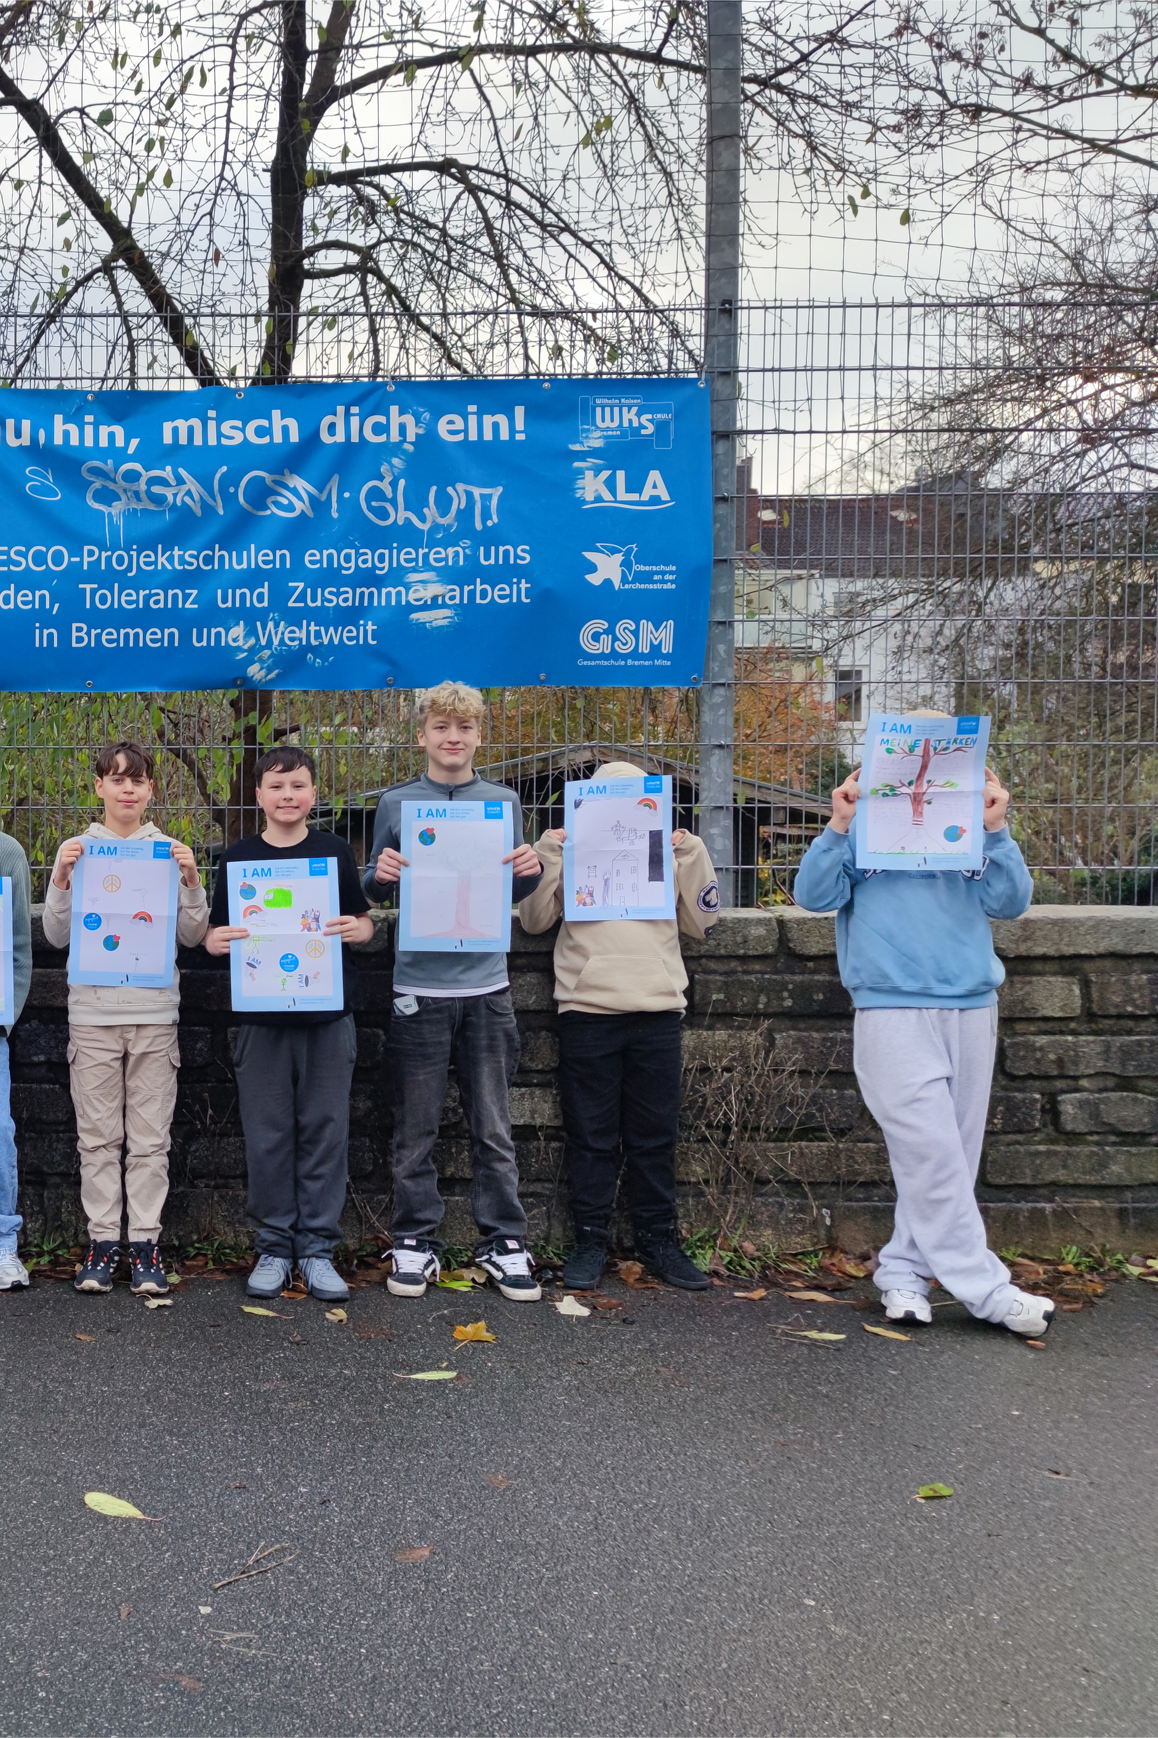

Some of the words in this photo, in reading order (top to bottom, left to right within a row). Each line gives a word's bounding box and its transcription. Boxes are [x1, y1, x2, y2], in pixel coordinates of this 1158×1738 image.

[53, 413, 141, 455] hin,
[162, 408, 300, 446] misch
[319, 405, 416, 444] dich
[437, 404, 526, 442] ein!
[584, 470, 671, 501] KLA
[304, 542, 465, 575] engagieren
[479, 544, 532, 566] uns
[78, 582, 199, 609] Toleranz
[216, 582, 269, 608] und
[34, 622, 58, 648] in
[71, 622, 180, 648] Bremen
[192, 620, 244, 647] und
[255, 620, 378, 646] Weltweit
[579, 619, 674, 654] GSM
[881, 722, 887, 732] I
[889, 723, 912, 734] AM
[578, 787, 583, 796] I
[586, 785, 607, 795] AM
[417, 808, 422, 818] I
[426, 808, 447, 818] AM
[89, 845, 94, 855] I
[97, 846, 118, 856] AM
[242, 868, 247, 878] I
[251, 867, 272, 877] AM
